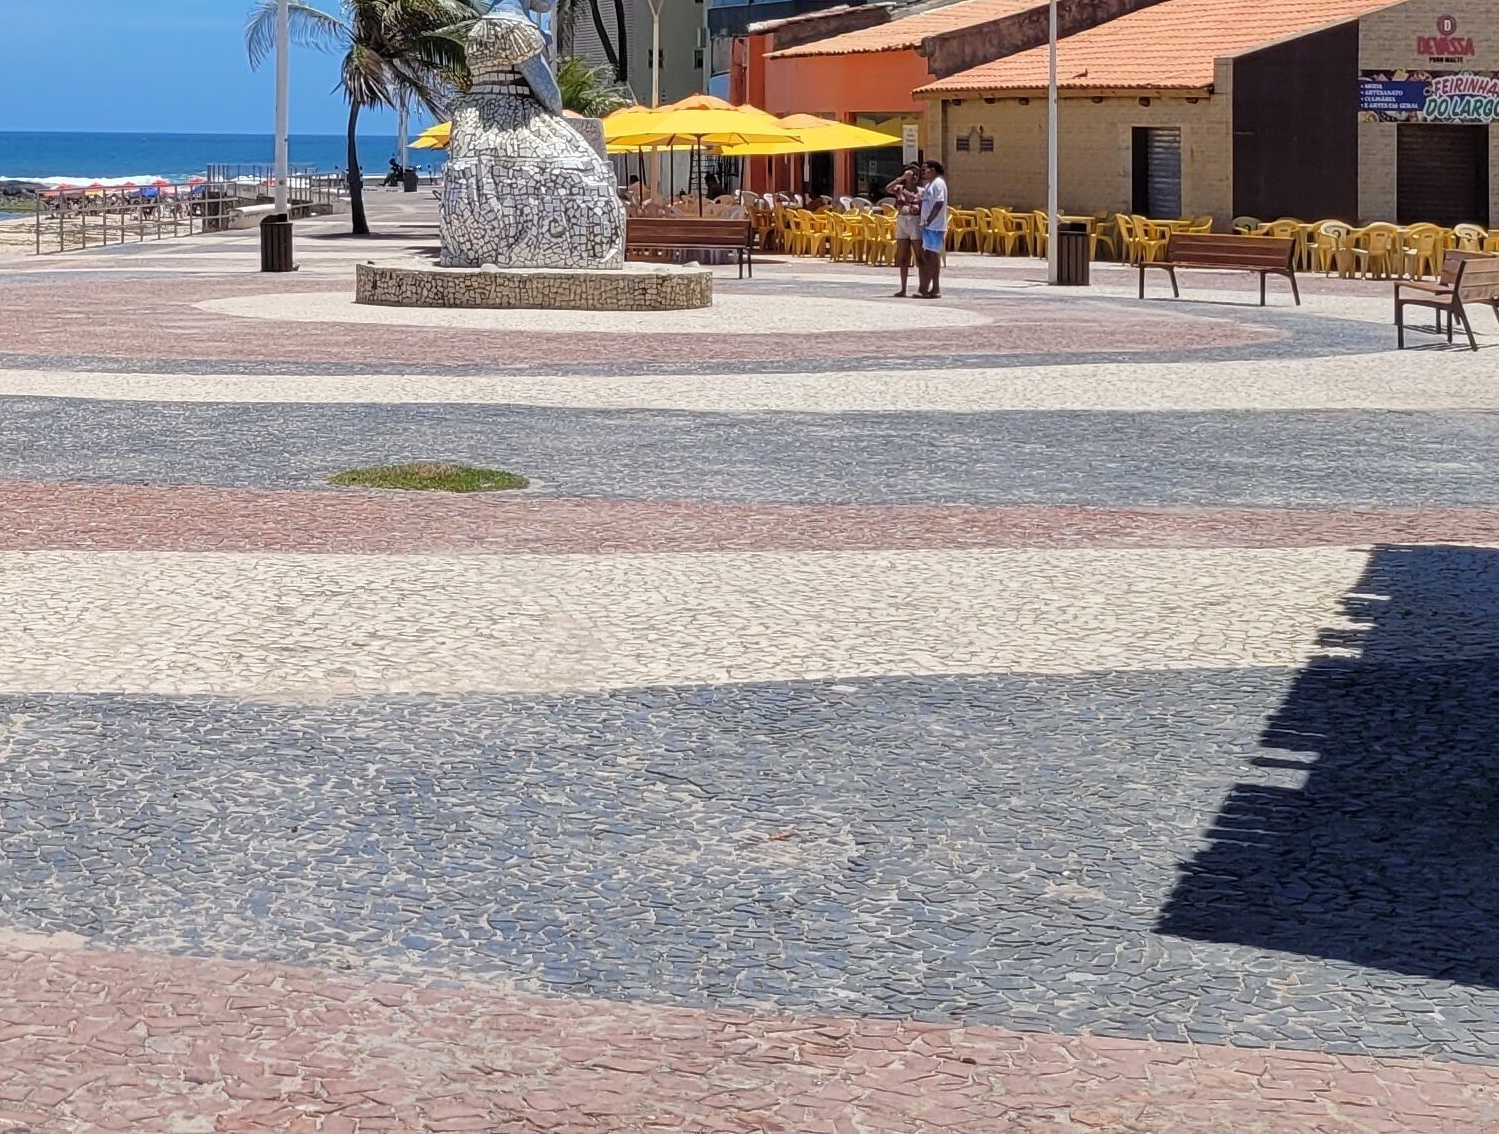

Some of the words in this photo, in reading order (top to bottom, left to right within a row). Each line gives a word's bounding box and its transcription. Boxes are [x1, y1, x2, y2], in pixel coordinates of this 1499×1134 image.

[1443, 19, 1452, 32] D
[1417, 36, 1475, 56] DEVASSA
[1433, 76, 1499, 97] FEIRINHA
[1425, 98, 1449, 117] DO
